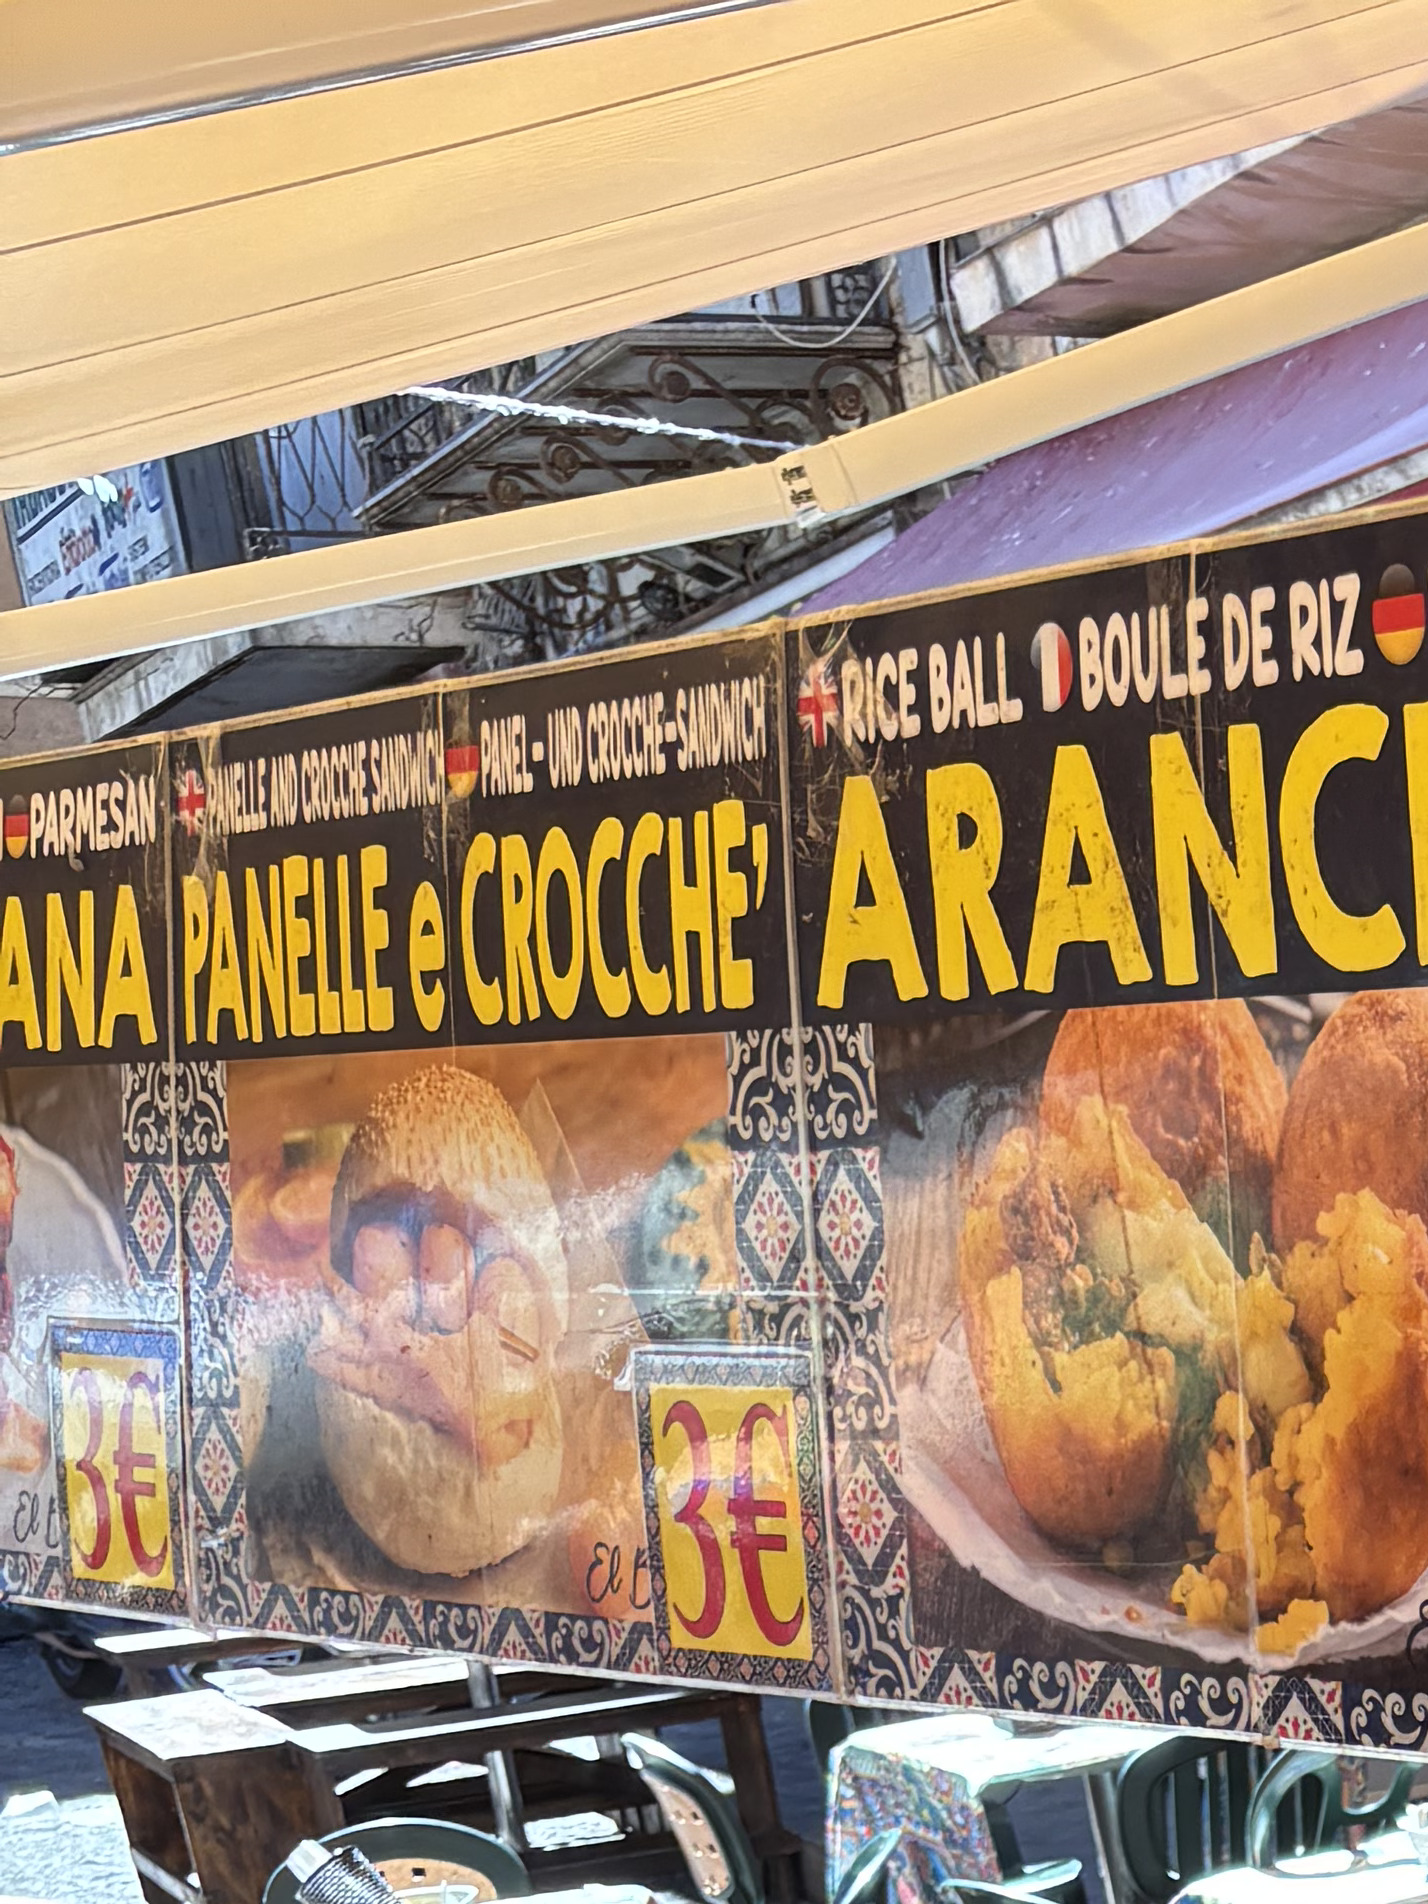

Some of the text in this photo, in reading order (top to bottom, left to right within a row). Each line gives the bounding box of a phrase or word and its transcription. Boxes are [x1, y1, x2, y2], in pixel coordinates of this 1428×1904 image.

[842, 648, 920, 741] RICE
[930, 631, 1023, 735] BALL
[1078, 598, 1208, 713] BOULE
[1223, 584, 1277, 691] DE
[1289, 573, 1363, 678] RIZ
[30, 776, 156, 859] PARMESAN
[206, 758, 267, 836] PANELLE
[271, 753, 297, 829] AND
[301, 740, 368, 824] CROCCHE
[371, 729, 446, 814] SANDWICH
[548, 706, 583, 788] UND
[587, 674, 767, 784] CROCCHE-SANDWICH
[0, 884, 157, 1052] ANA
[182, 845, 394, 1045] PANELLE
[410, 881, 445, 1032] e
[70, 1367, 168, 1577] 3€
[662, 1400, 804, 1646] 3€
